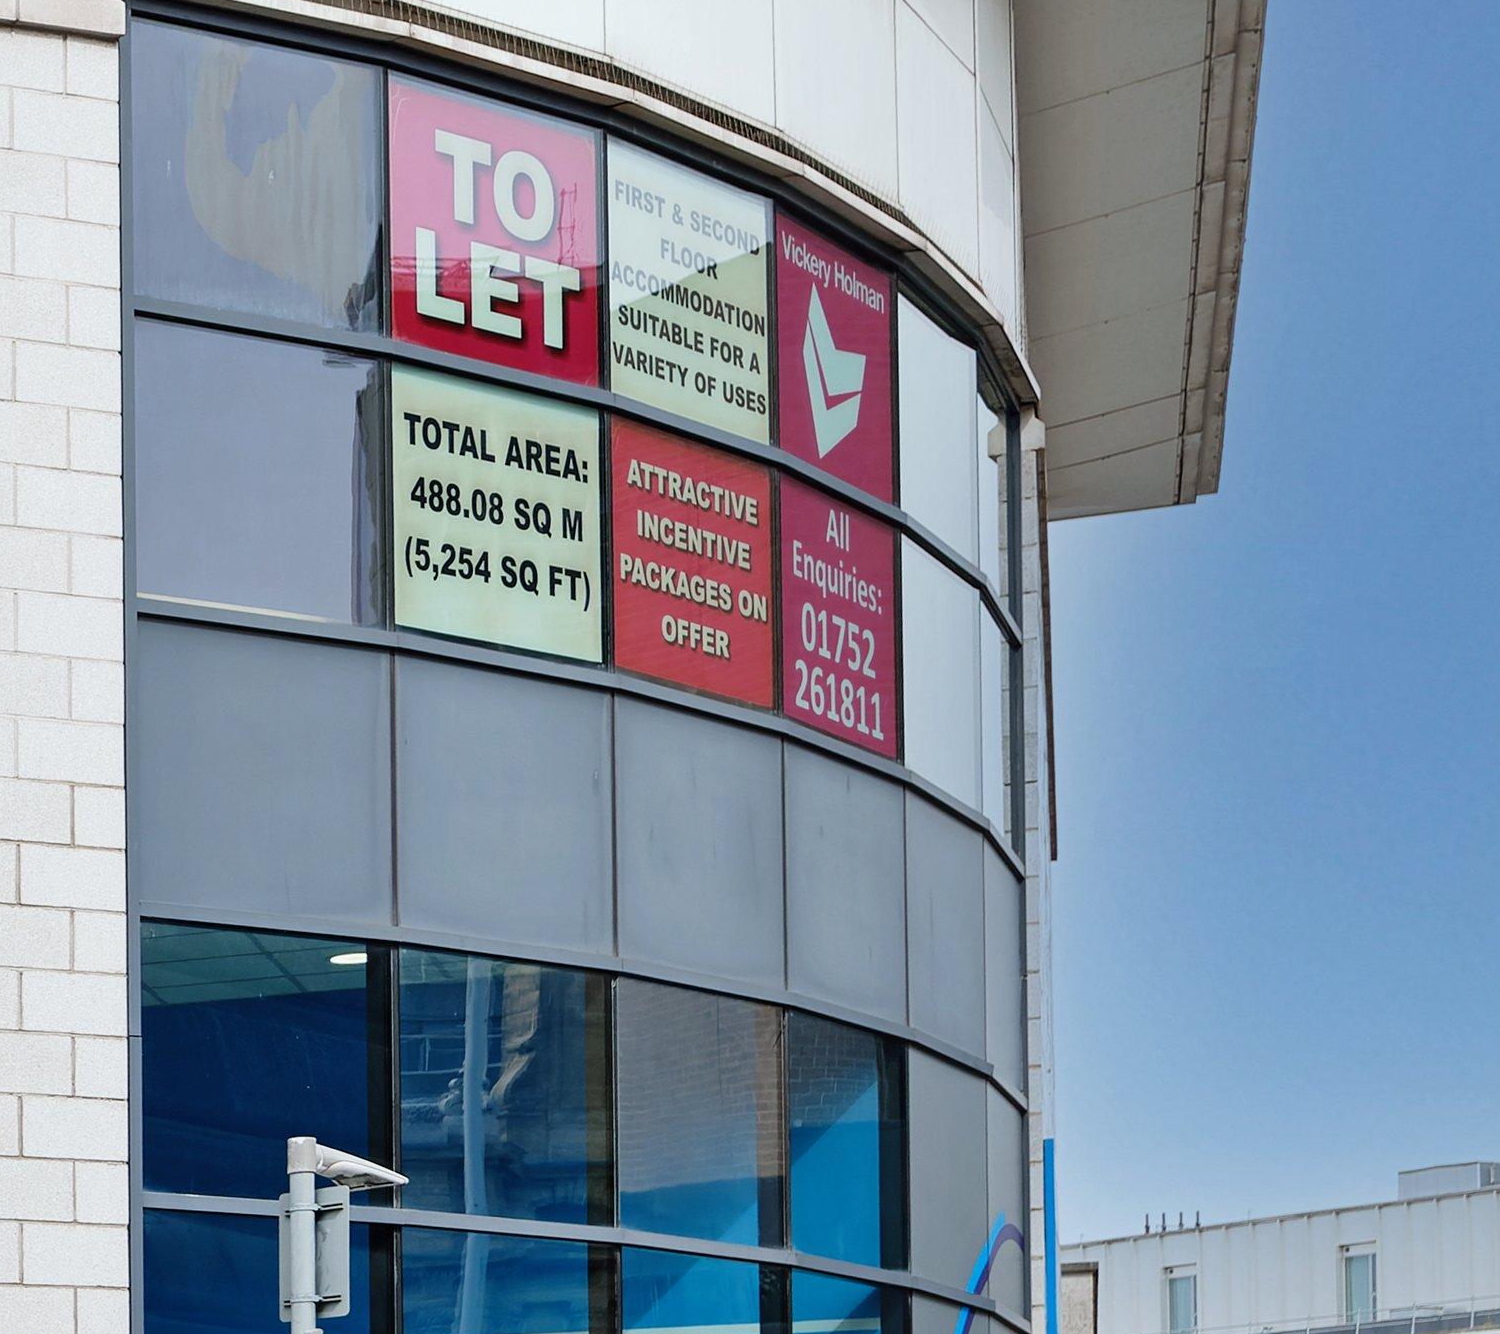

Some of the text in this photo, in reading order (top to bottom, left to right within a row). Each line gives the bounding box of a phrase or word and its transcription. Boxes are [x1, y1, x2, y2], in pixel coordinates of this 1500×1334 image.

[435, 129, 555, 242] TO
[615, 179, 760, 255] FIRST & SECOND
[415, 226, 580, 350] LET
[660, 238, 718, 280] FLOOR
[781, 230, 885, 315] Vickery Holman
[611, 260, 765, 338] ACCOMMODATION
[618, 304, 761, 375] SUITABLE FOR A
[612, 341, 767, 415] VARIETY OF USES
[403, 412, 589, 484] TOTAL AREA:
[410, 476, 584, 542] 488.08 SQ M
[626, 458, 759, 526] ATTRACTIVE
[636, 509, 752, 571] INCENTIVE
[825, 509, 850, 552] All
[405, 535, 591, 612] (5,254 SQ FT)
[619, 552, 768, 623] PACKAGES ON
[792, 539, 883, 615] Enquiries:
[660, 614, 731, 660] OFFER
[801, 601, 877, 679] 01752
[794, 658, 884, 741] 261811
